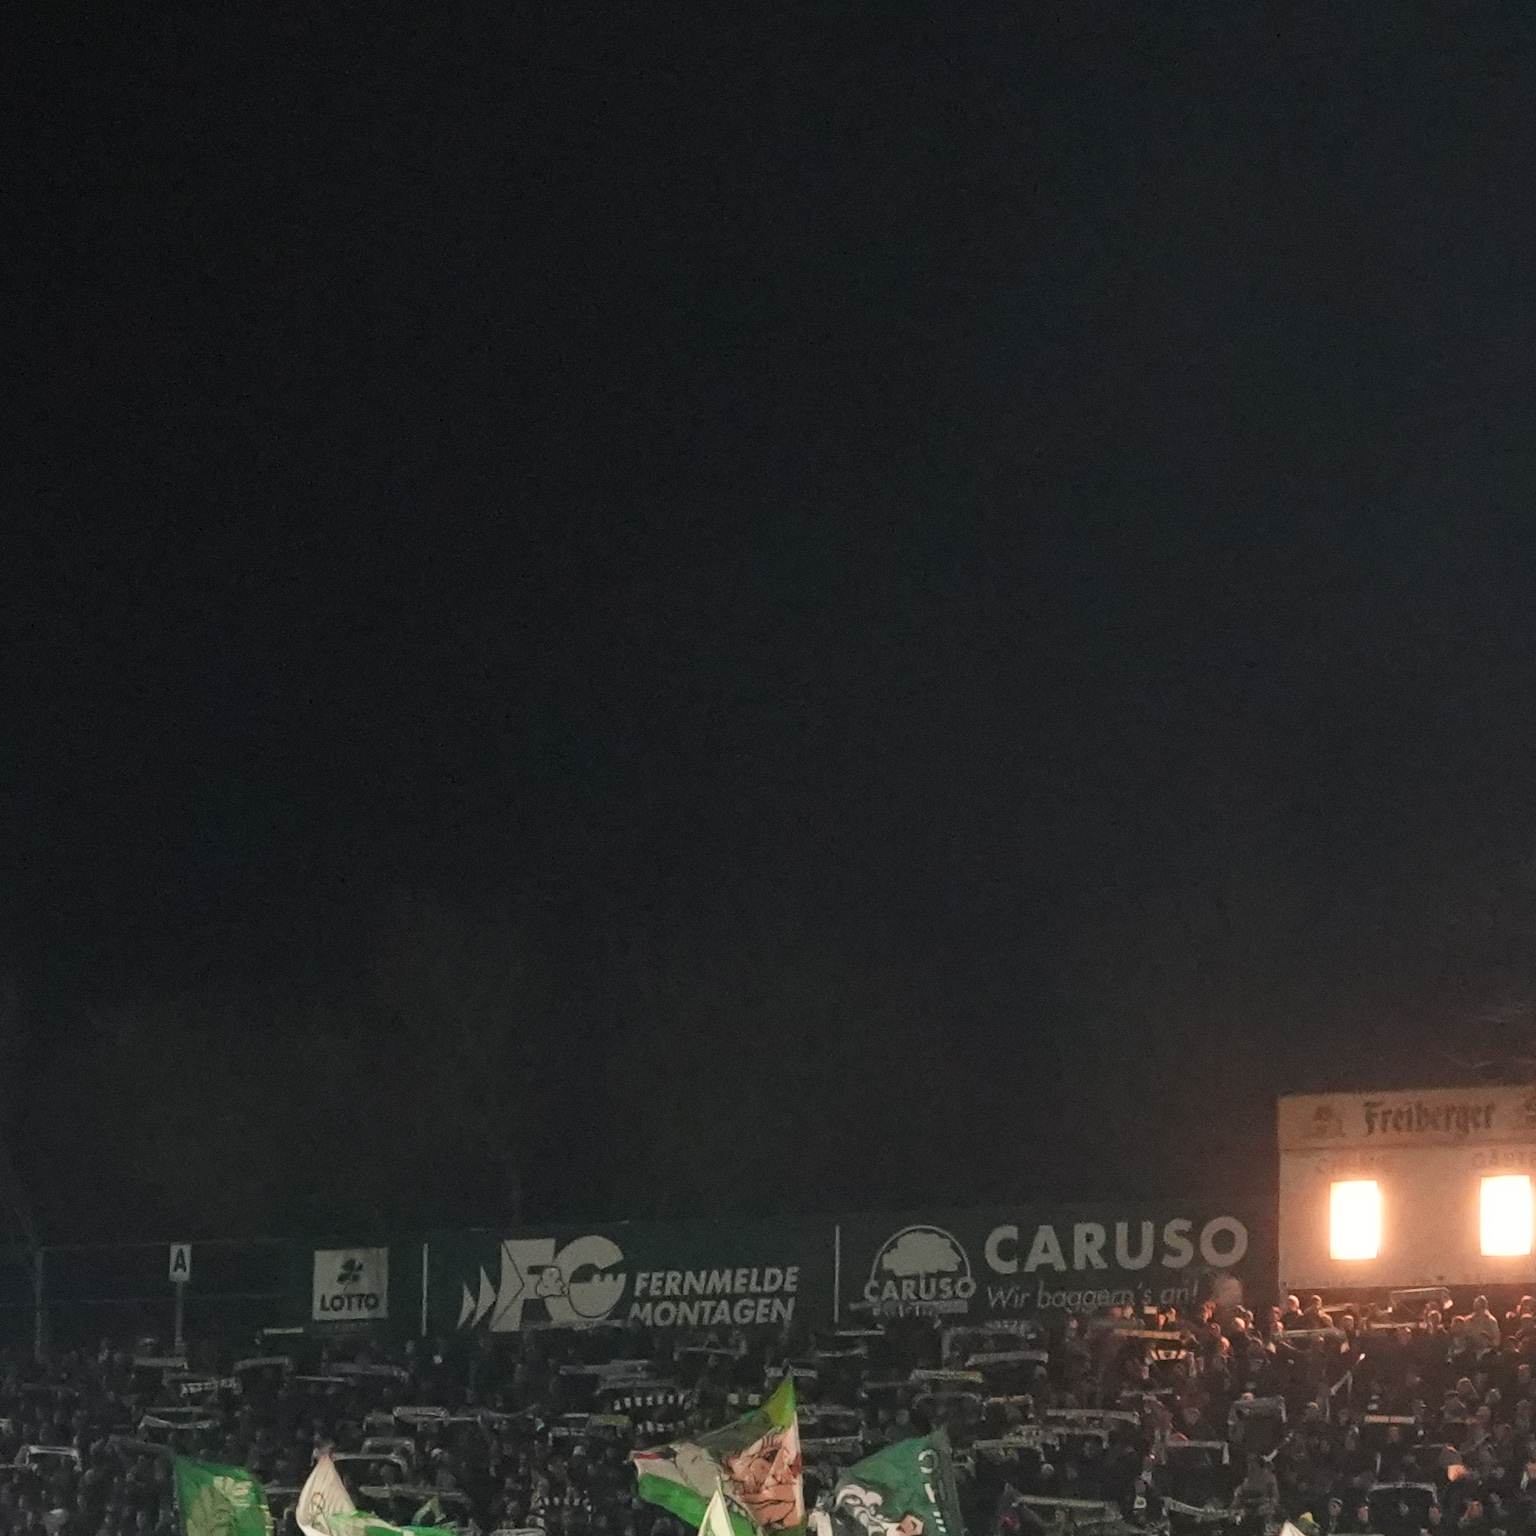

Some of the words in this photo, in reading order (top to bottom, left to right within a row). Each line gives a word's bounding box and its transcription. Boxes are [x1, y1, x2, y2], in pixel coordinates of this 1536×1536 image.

[1363, 1100, 1496, 1136] Freiberger
[983, 1214, 1249, 1275] CARUSO
[173, 1248, 187, 1273] A
[633, 1265, 801, 1298] FERNMELDE
[864, 1275, 977, 1302] CARUSO
[985, 1282, 1032, 1310] Wir
[1159, 1279, 1199, 1306] an!
[319, 1293, 380, 1313] LOTTO
[626, 1297, 797, 1329] MONTAGEN
